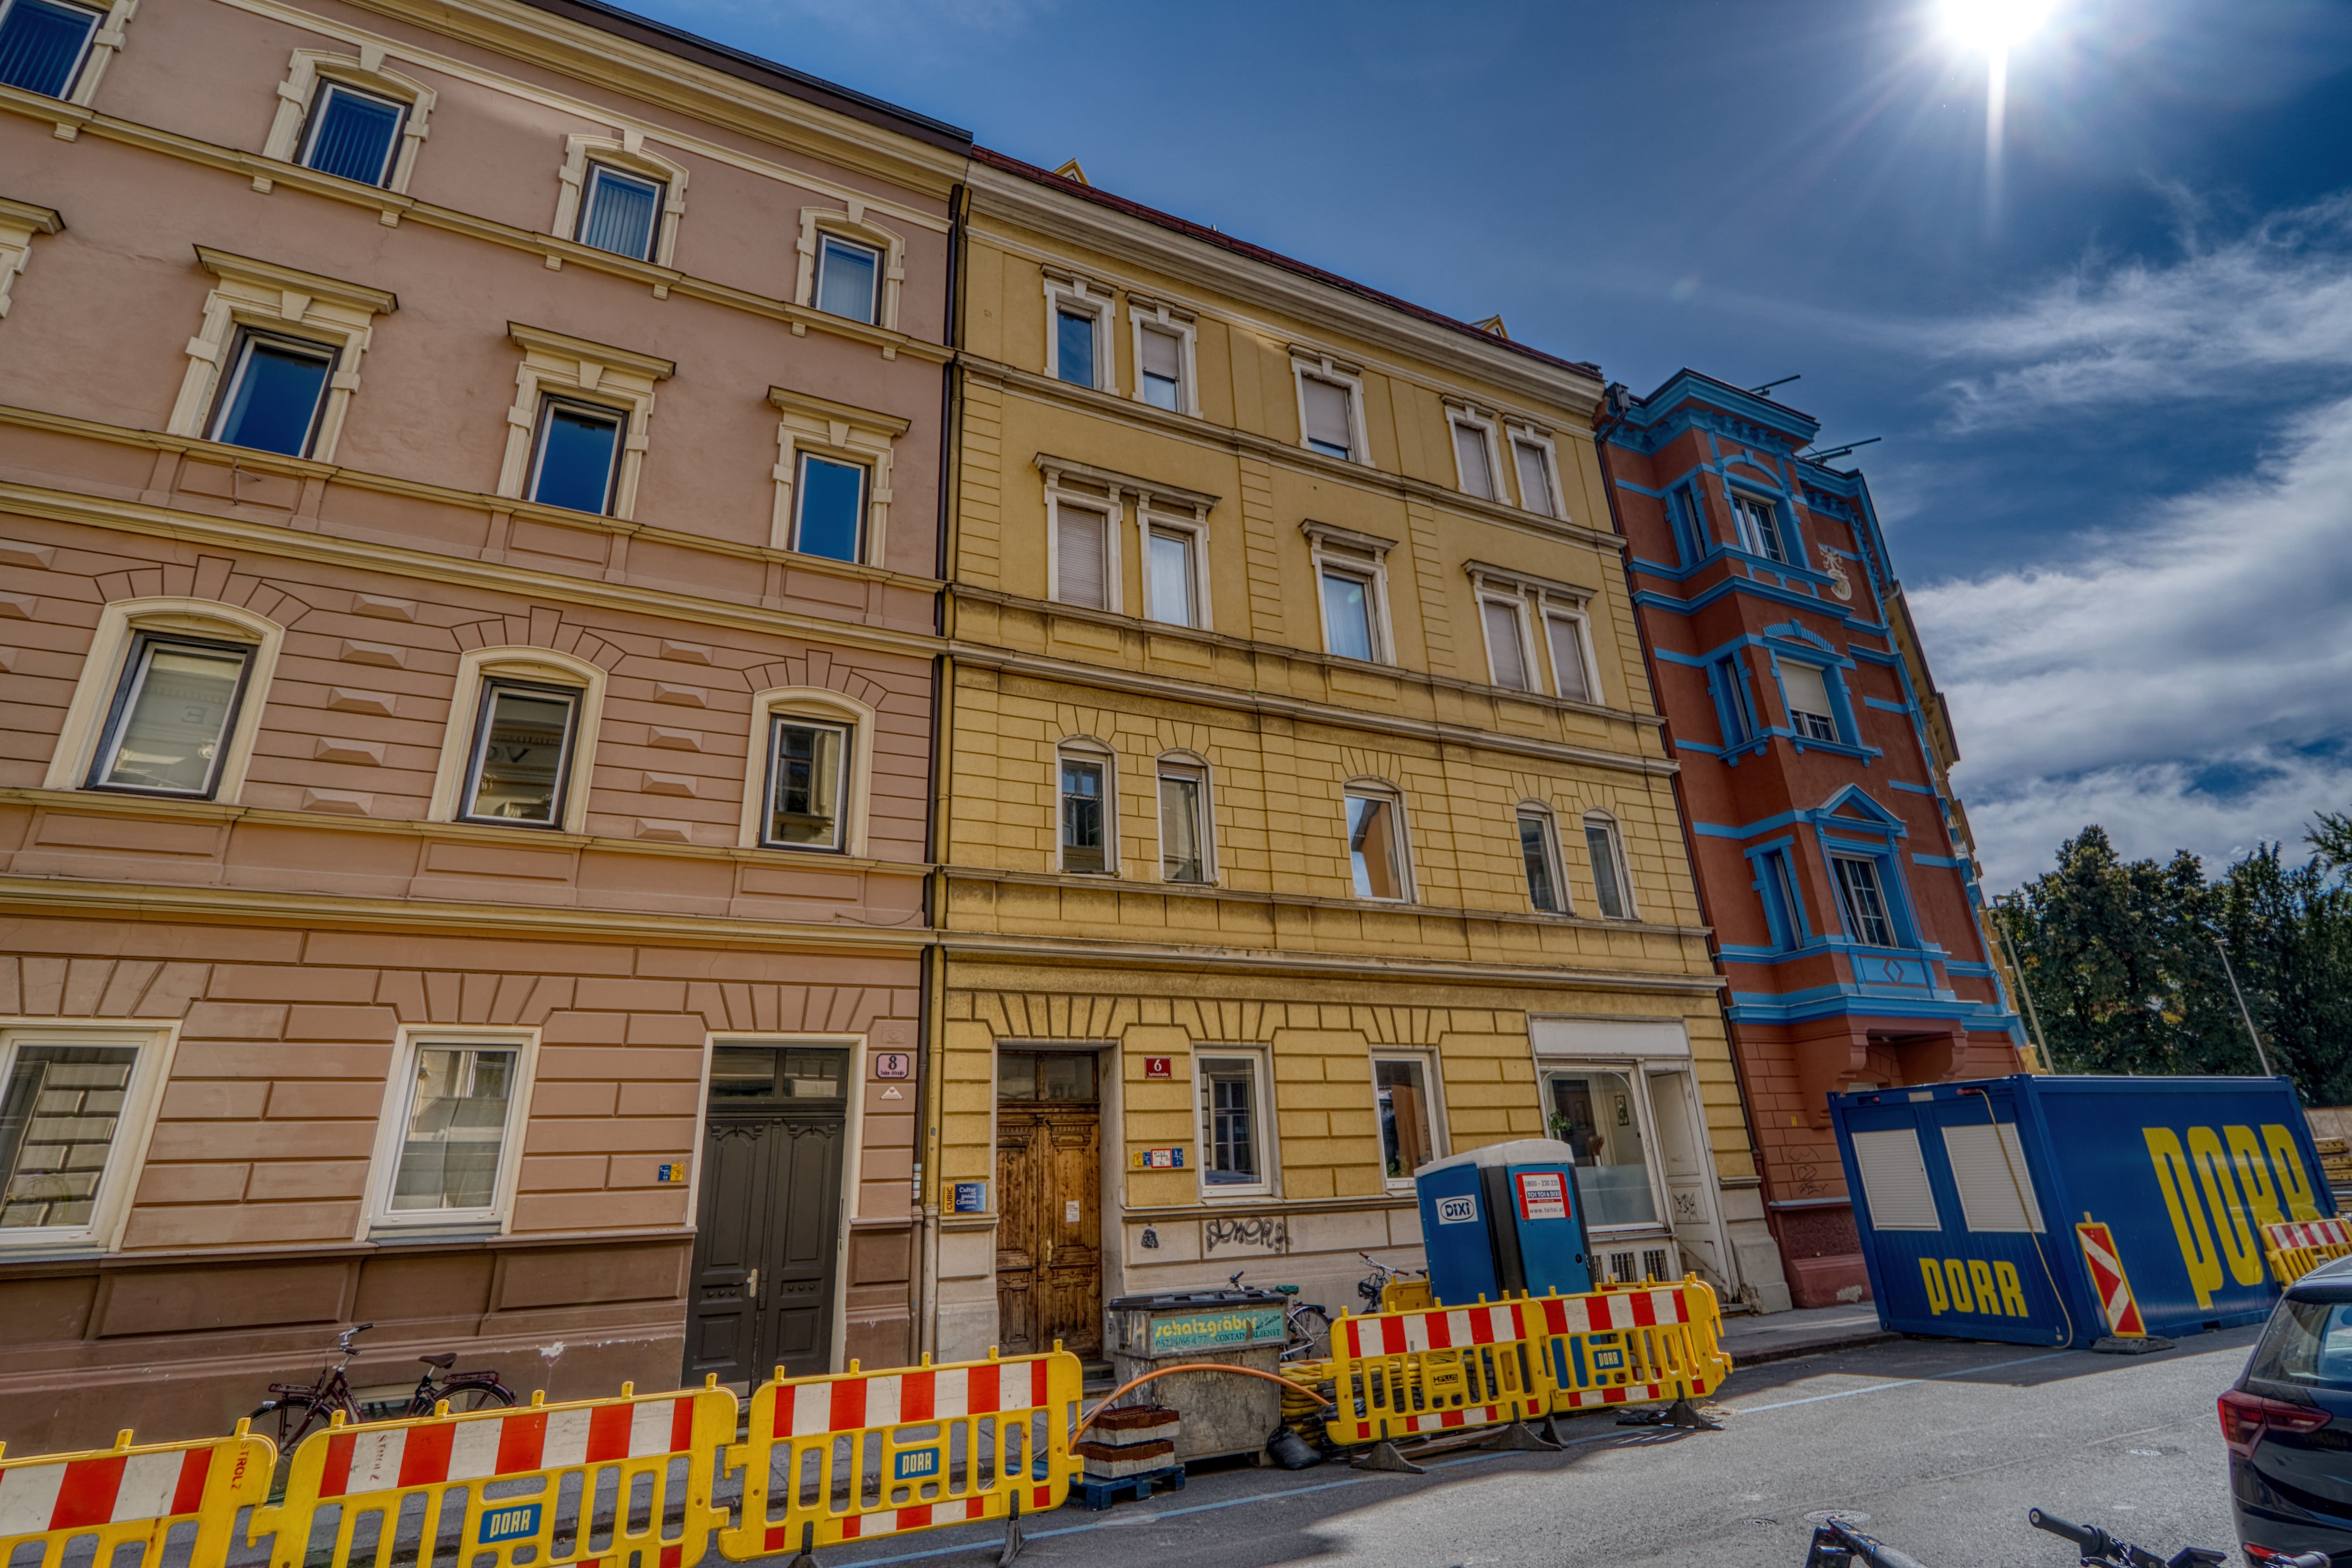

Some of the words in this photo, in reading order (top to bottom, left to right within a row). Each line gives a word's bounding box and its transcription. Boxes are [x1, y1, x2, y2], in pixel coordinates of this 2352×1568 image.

[888, 1055, 897, 1070] 8
[1154, 1059, 1162, 1072] 6
[2141, 1124, 2322, 1310] PORR
[1919, 1257, 2029, 1318] PORR
[1215, 1329, 1281, 1341] CONTAINRDIENST
[1598, 1352, 1619, 1367] PORR
[345, 1387, 361, 1413] VICTORIA
[230, 1442, 250, 1492] STROLZ
[902, 1452, 932, 1476] PORR
[489, 1509, 532, 1538] PORR
